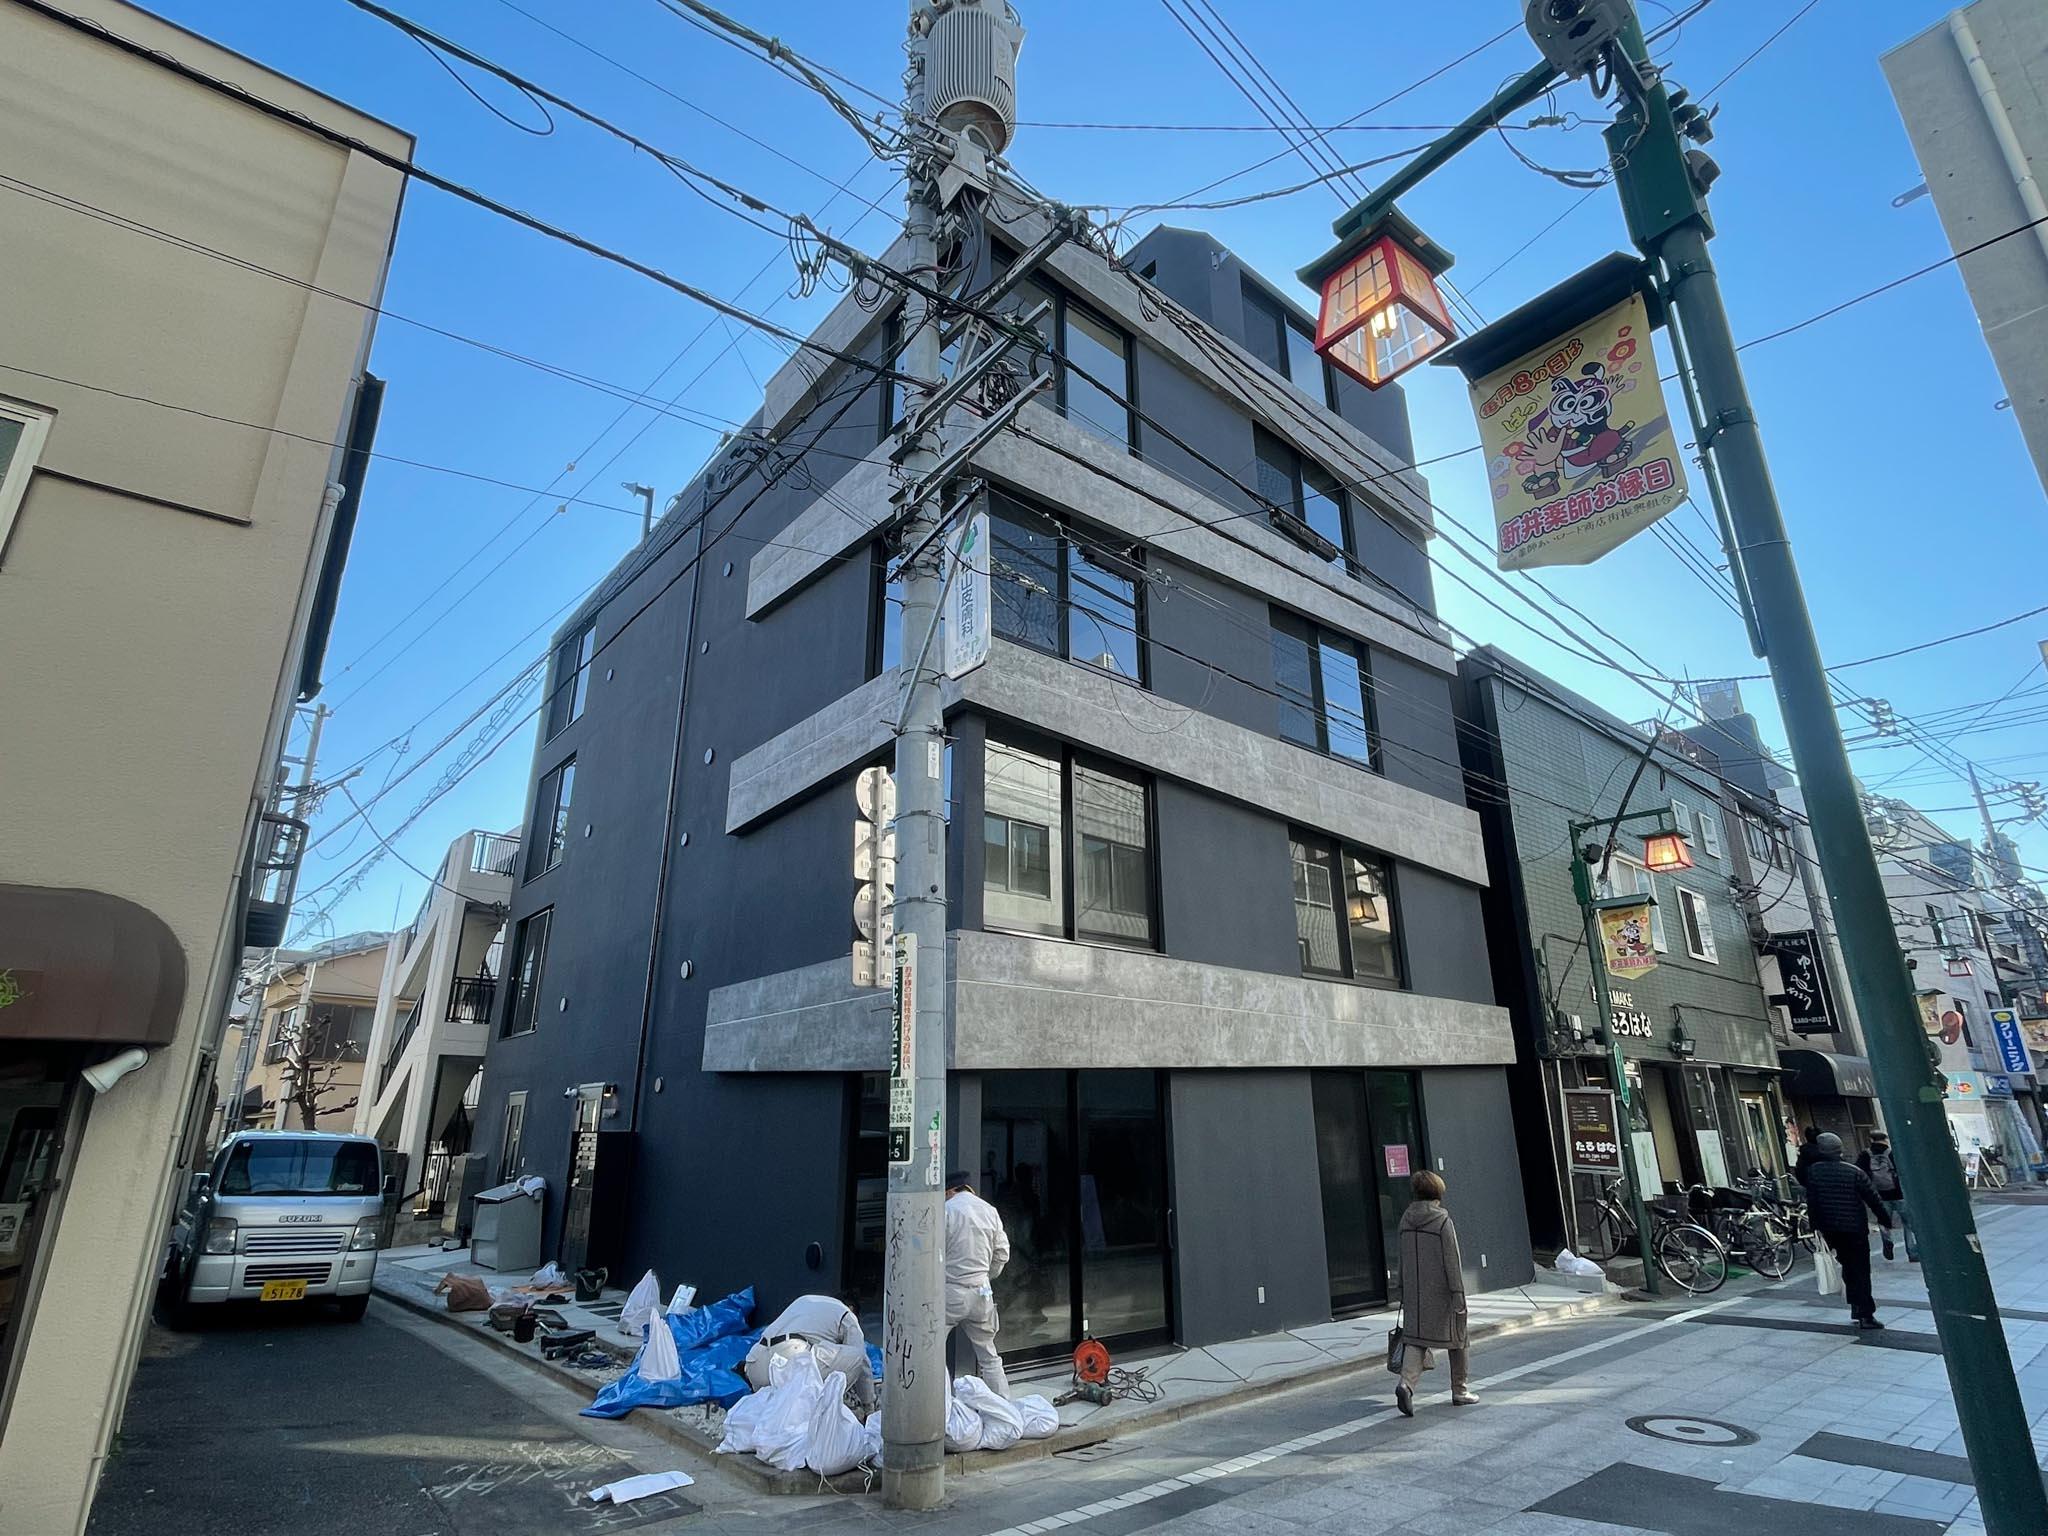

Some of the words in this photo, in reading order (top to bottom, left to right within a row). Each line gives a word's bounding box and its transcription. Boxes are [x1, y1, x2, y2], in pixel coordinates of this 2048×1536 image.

[1481, 340, 1583, 418] 毎月8の日は
[1501, 459, 1675, 552] 新井薬師お縁日
[1612, 990, 1633, 1007] MAKE
[2000, 1022, 2025, 1072] クリーニング
[279, 1215, 322, 1223] SUZUKI
[271, 1287, 303, 1299] 51-78
